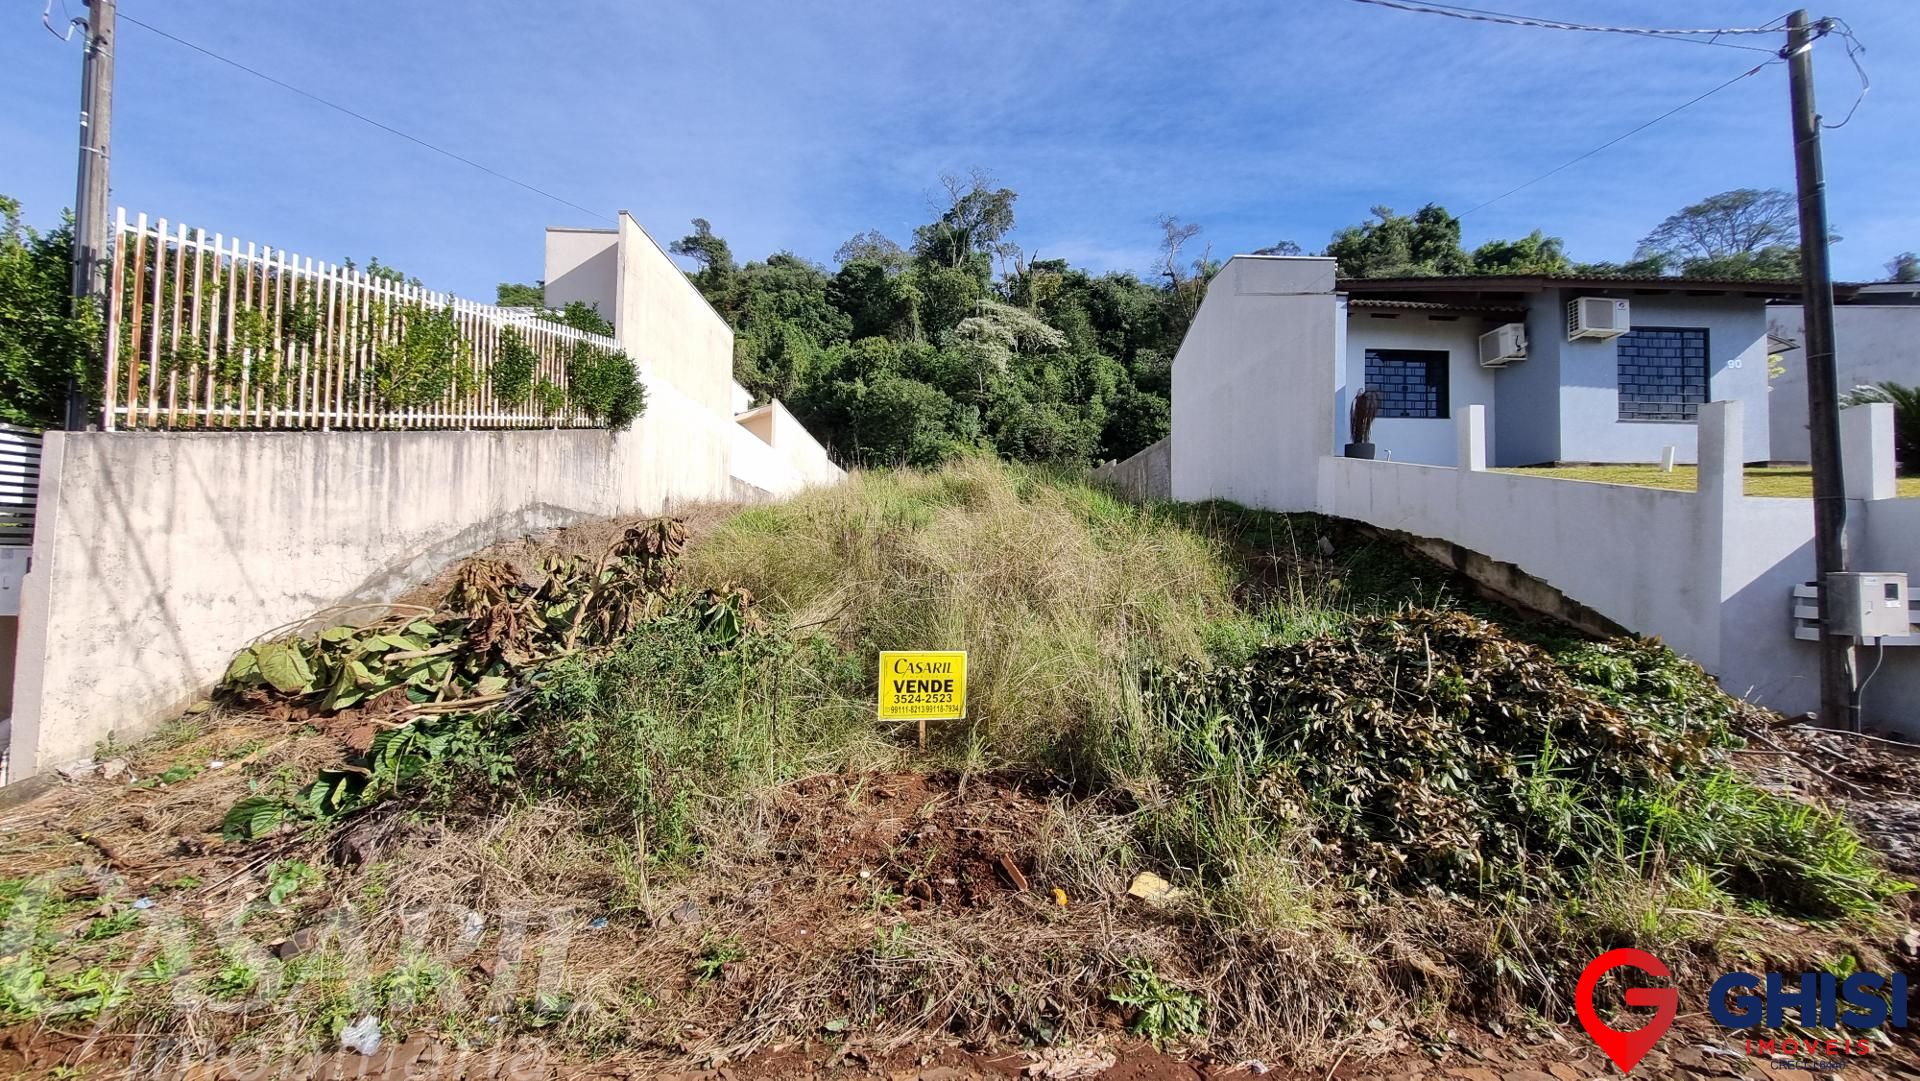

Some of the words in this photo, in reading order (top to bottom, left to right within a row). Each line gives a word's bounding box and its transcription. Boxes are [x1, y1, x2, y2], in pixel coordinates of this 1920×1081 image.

[1727, 359, 1742, 369] 90
[894, 658, 953, 678] CASARIL
[893, 679, 954, 694] VENDE
[893, 693, 953, 704] 3524-2523
